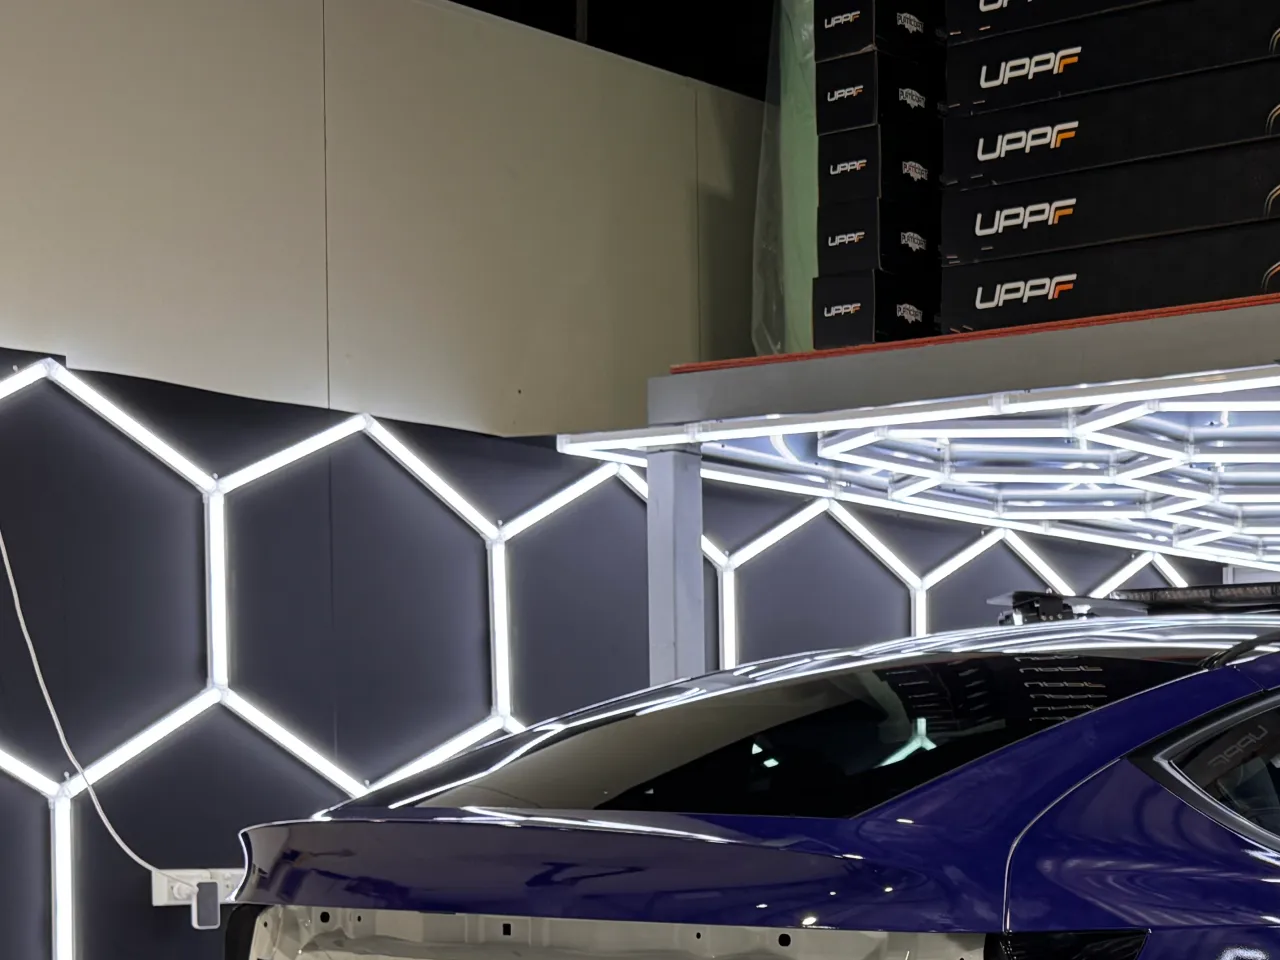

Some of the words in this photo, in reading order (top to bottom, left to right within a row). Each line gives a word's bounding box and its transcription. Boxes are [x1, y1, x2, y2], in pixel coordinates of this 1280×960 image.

[824, 10, 861, 29] UPPF
[979, 46, 1082, 89] UPPF
[827, 84, 864, 102] UPPF
[976, 120, 1079, 162] UPPF
[829, 159, 867, 175] UPPF
[975, 198, 1077, 237] UPPF
[828, 231, 866, 247] UPPF
[975, 273, 1078, 310] UPPF
[823, 302, 862, 318] UPPF
